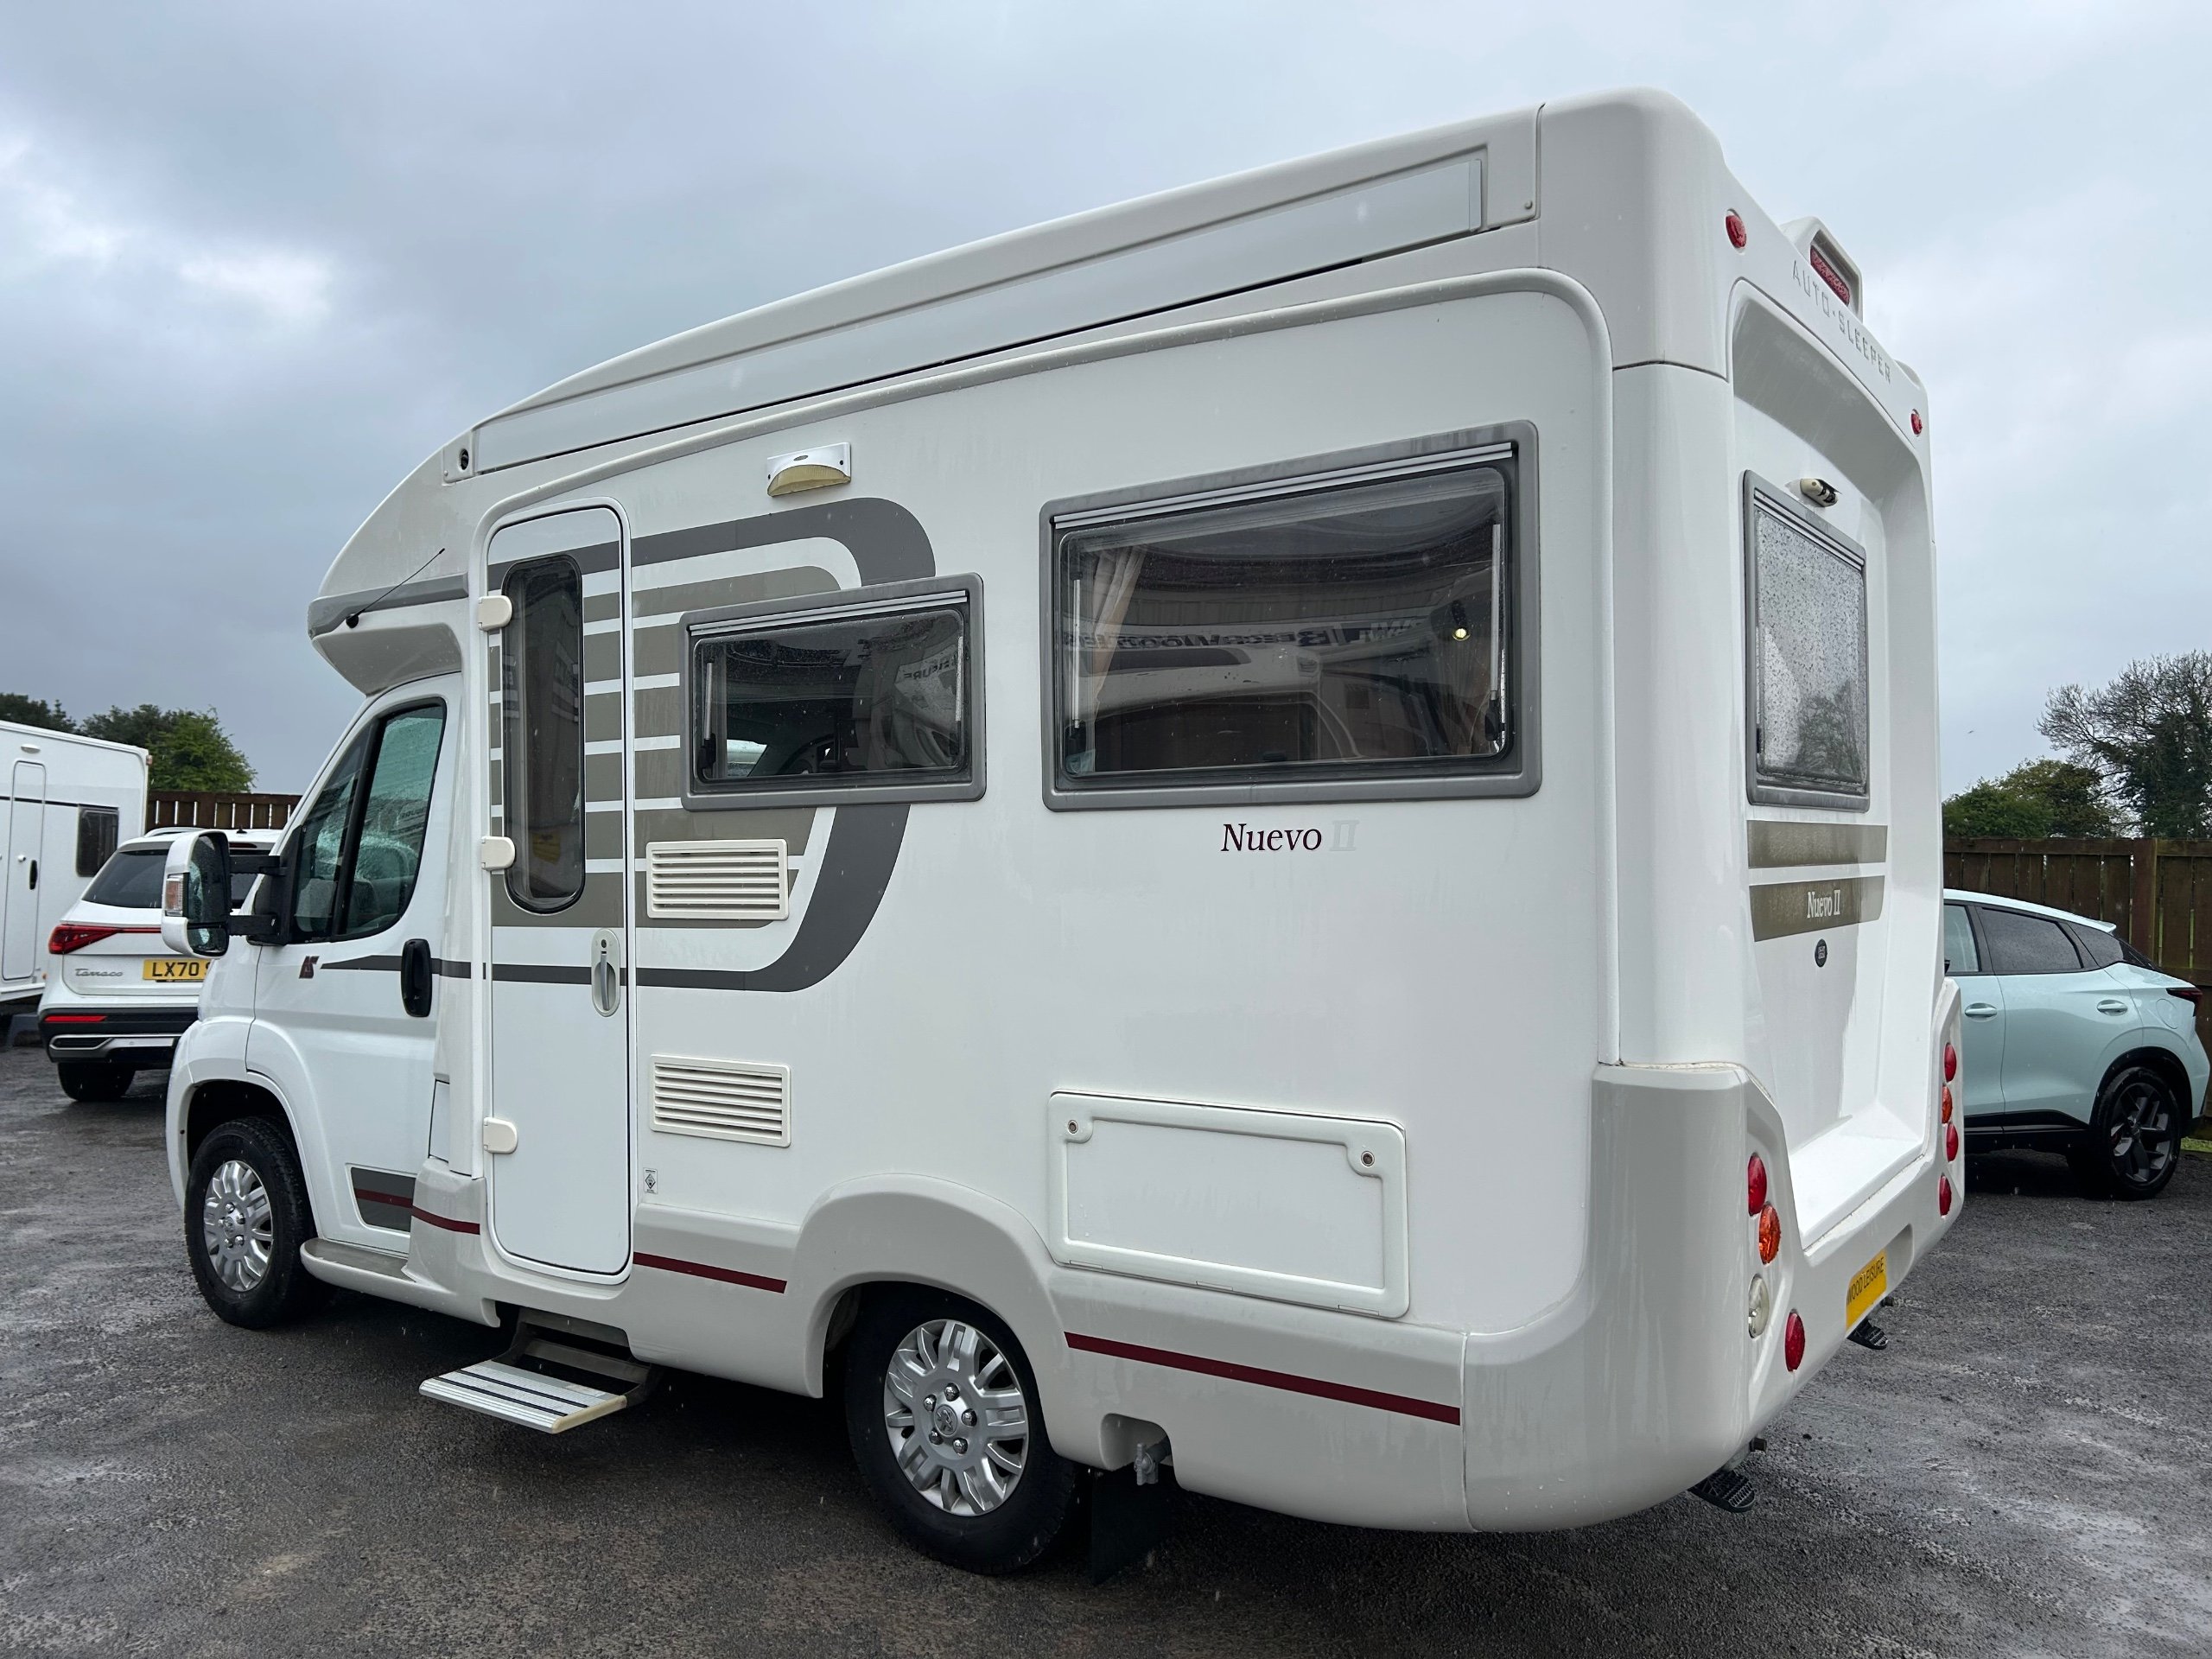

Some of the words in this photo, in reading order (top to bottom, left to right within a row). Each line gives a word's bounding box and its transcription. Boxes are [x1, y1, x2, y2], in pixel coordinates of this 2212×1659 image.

[1220, 823, 1323, 852] Nuevo
[1807, 891, 1833, 918] Nuevo
[1833, 889, 1841, 916] II
[74, 968, 124, 977] Tarraco
[152, 962, 200, 977] LX70
[1862, 1255, 1885, 1289] LEISURE
